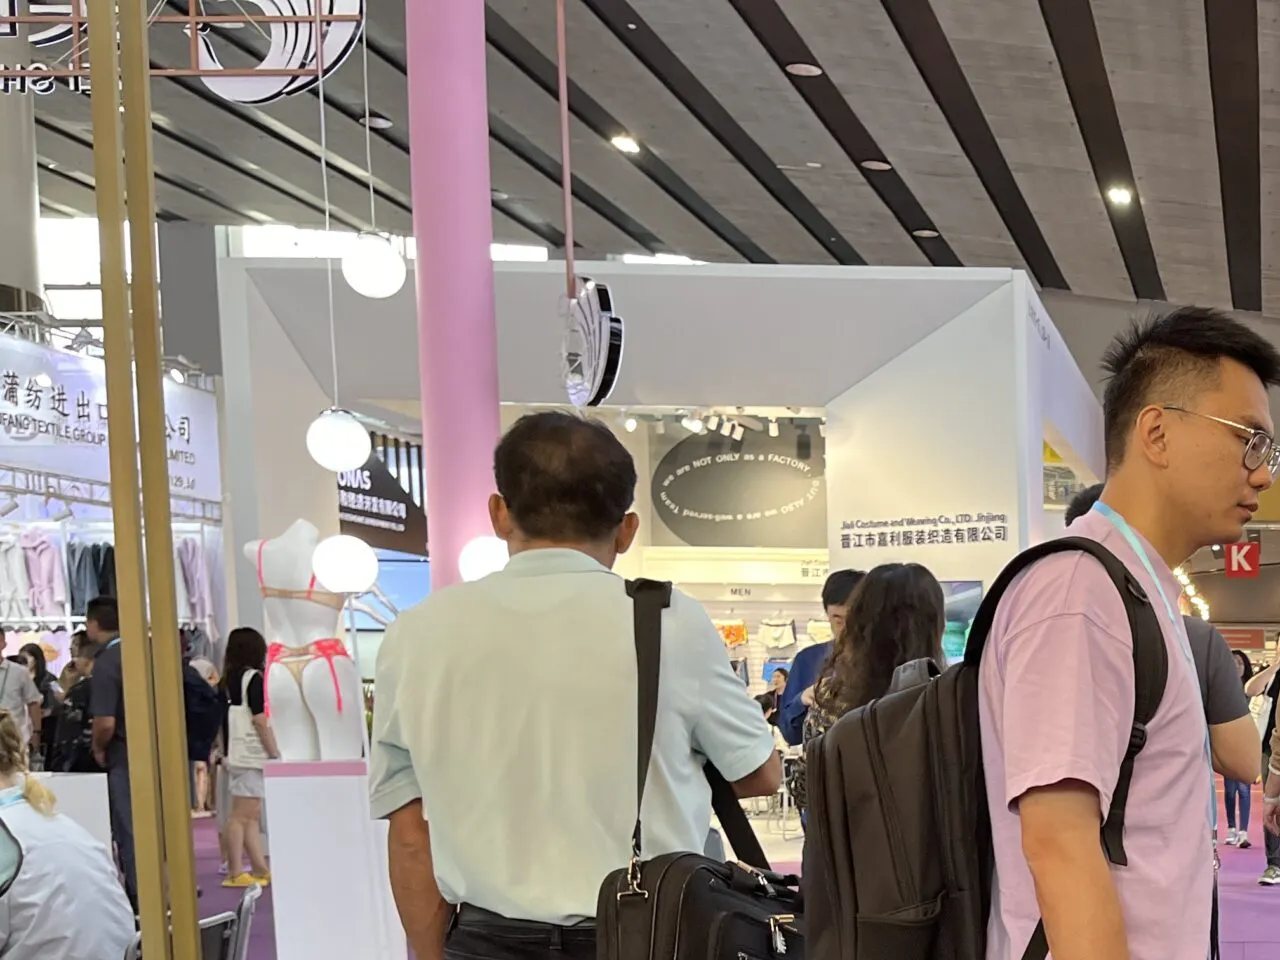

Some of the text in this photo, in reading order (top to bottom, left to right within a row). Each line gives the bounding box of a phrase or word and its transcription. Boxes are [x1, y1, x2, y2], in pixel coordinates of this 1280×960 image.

[0, 412, 30, 430] FANG
[32, 418, 71, 439] TEXTILE
[73, 427, 105, 445] GROUP
[693, 456, 712, 469] NOT
[716, 453, 740, 463] ONLY
[780, 498, 805, 514] ALSO
[1231, 545, 1252, 571] K
[731, 587, 751, 596] MEN
